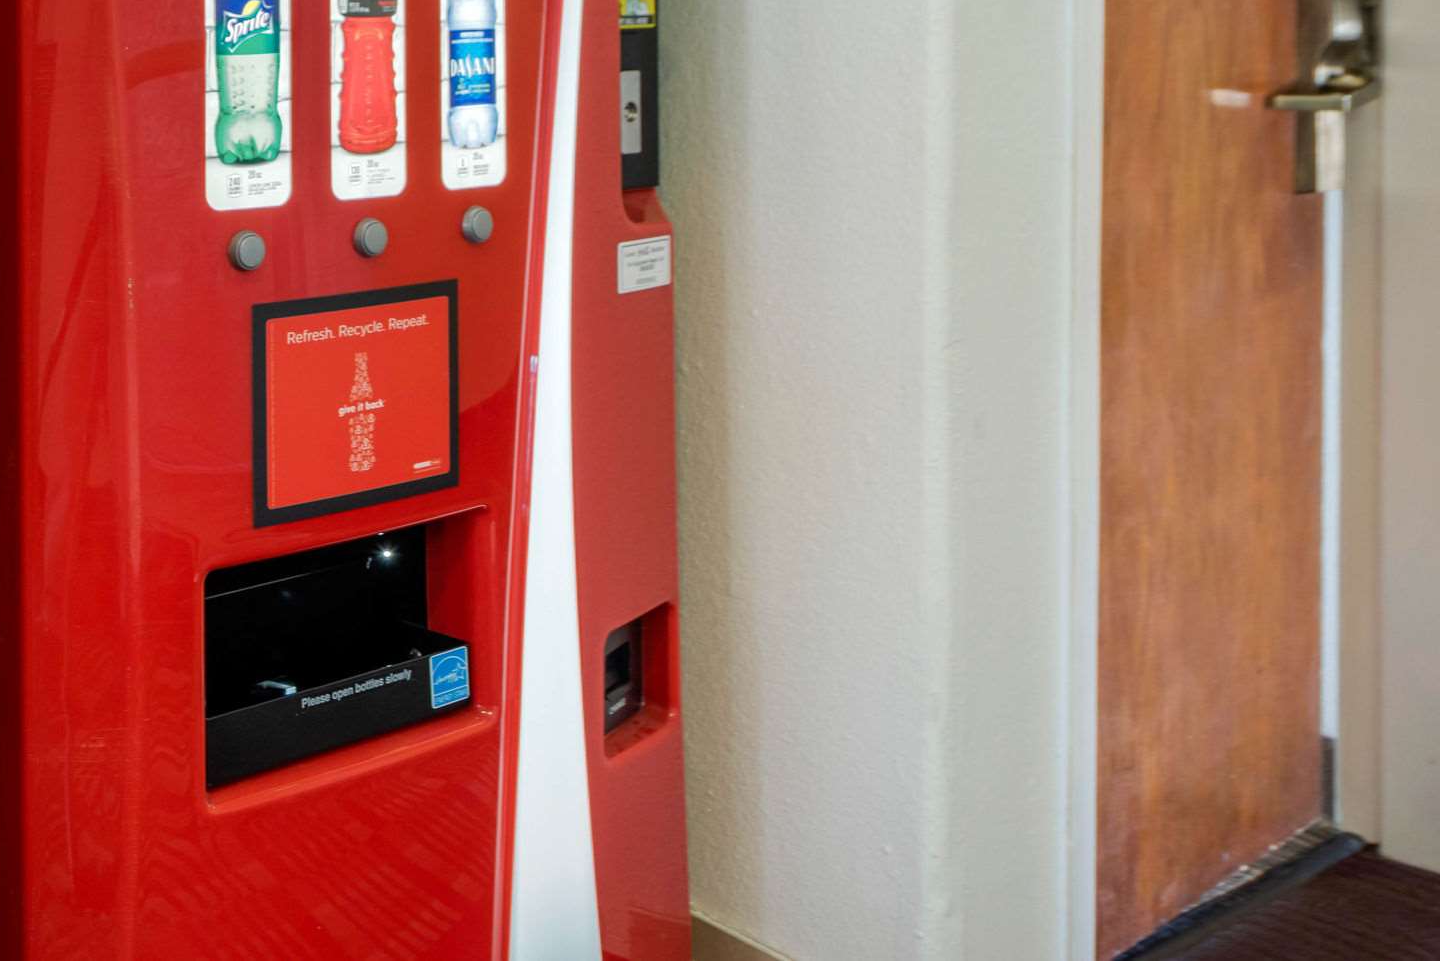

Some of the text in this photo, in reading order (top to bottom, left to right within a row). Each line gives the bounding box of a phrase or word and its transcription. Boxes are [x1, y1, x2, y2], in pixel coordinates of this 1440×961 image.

[224, 8, 271, 44] Sprite
[287, 314, 430, 345] Refresh. Recycle. Repeat.
[301, 693, 331, 709] Please
[331, 686, 354, 701] open
[354, 677, 385, 694] bottles
[385, 668, 413, 685] slowly
